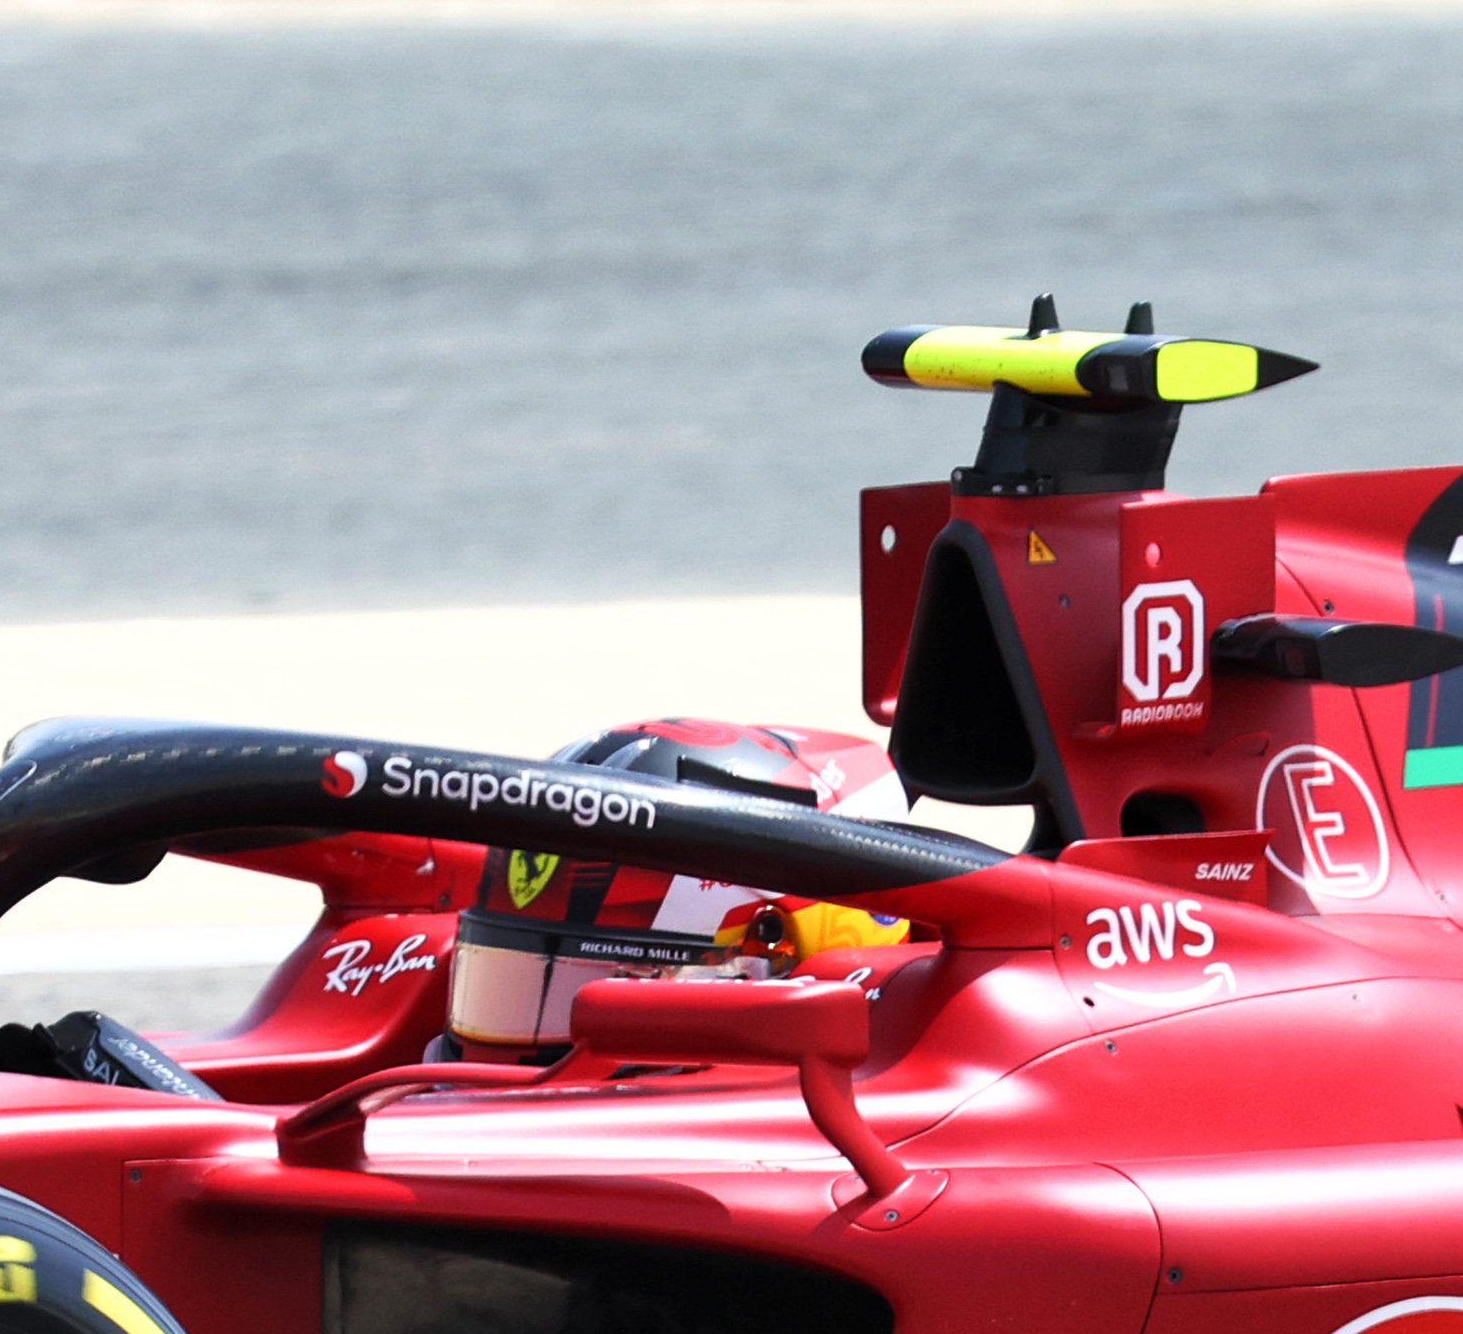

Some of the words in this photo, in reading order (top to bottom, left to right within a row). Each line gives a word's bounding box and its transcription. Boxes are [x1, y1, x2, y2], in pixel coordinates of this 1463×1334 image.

[1122, 702, 1204, 727] RADIOBOOK
[382, 755, 656, 829] Snapdragon
[1195, 863, 1254, 880] SAINZ
[1086, 899, 1215, 968] aws
[580, 942, 645, 957] RICHARD
[647, 948, 691, 961] MILLE
